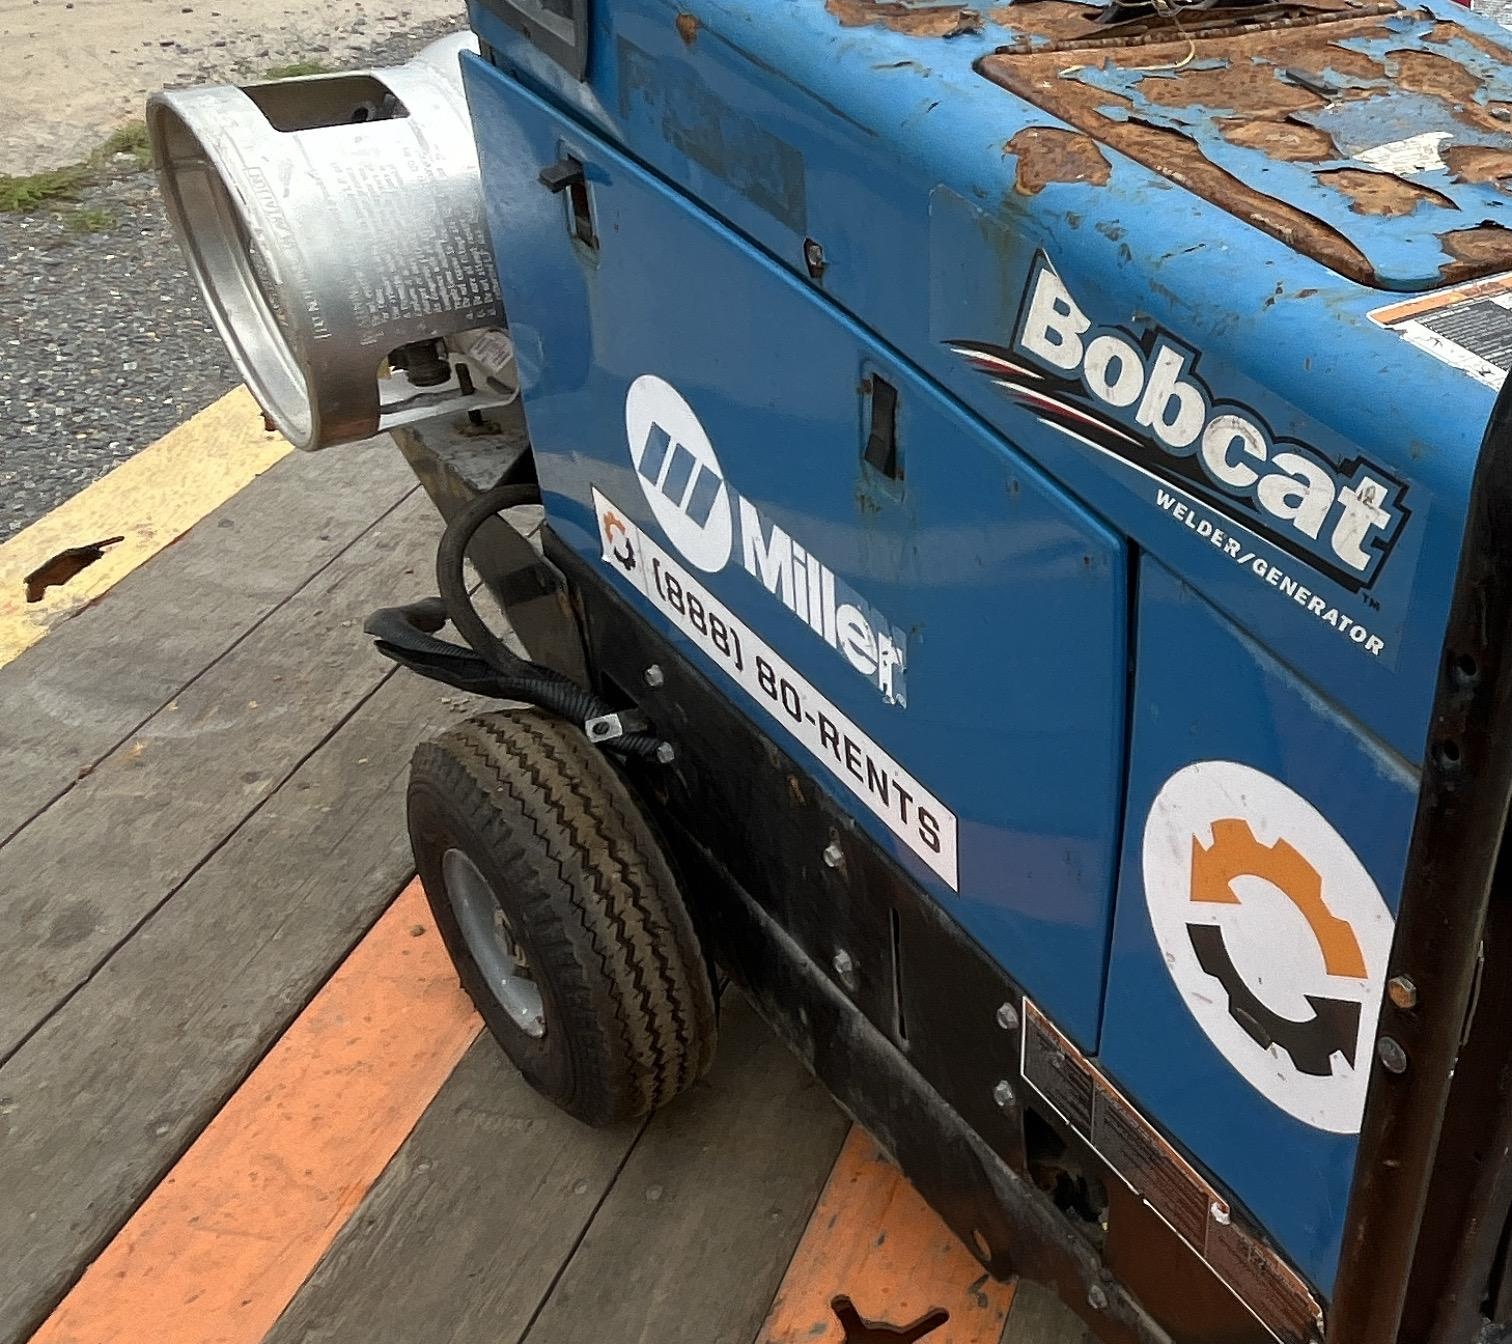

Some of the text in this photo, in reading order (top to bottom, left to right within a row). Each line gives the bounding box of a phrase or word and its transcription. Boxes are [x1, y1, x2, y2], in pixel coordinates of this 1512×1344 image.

[1021, 268, 1391, 571] Bobcat
[739, 496, 905, 703] Miller
[1155, 489, 1385, 657] WELDER/GENERATOR
[654, 557, 941, 854] (888) 80-RENTS
